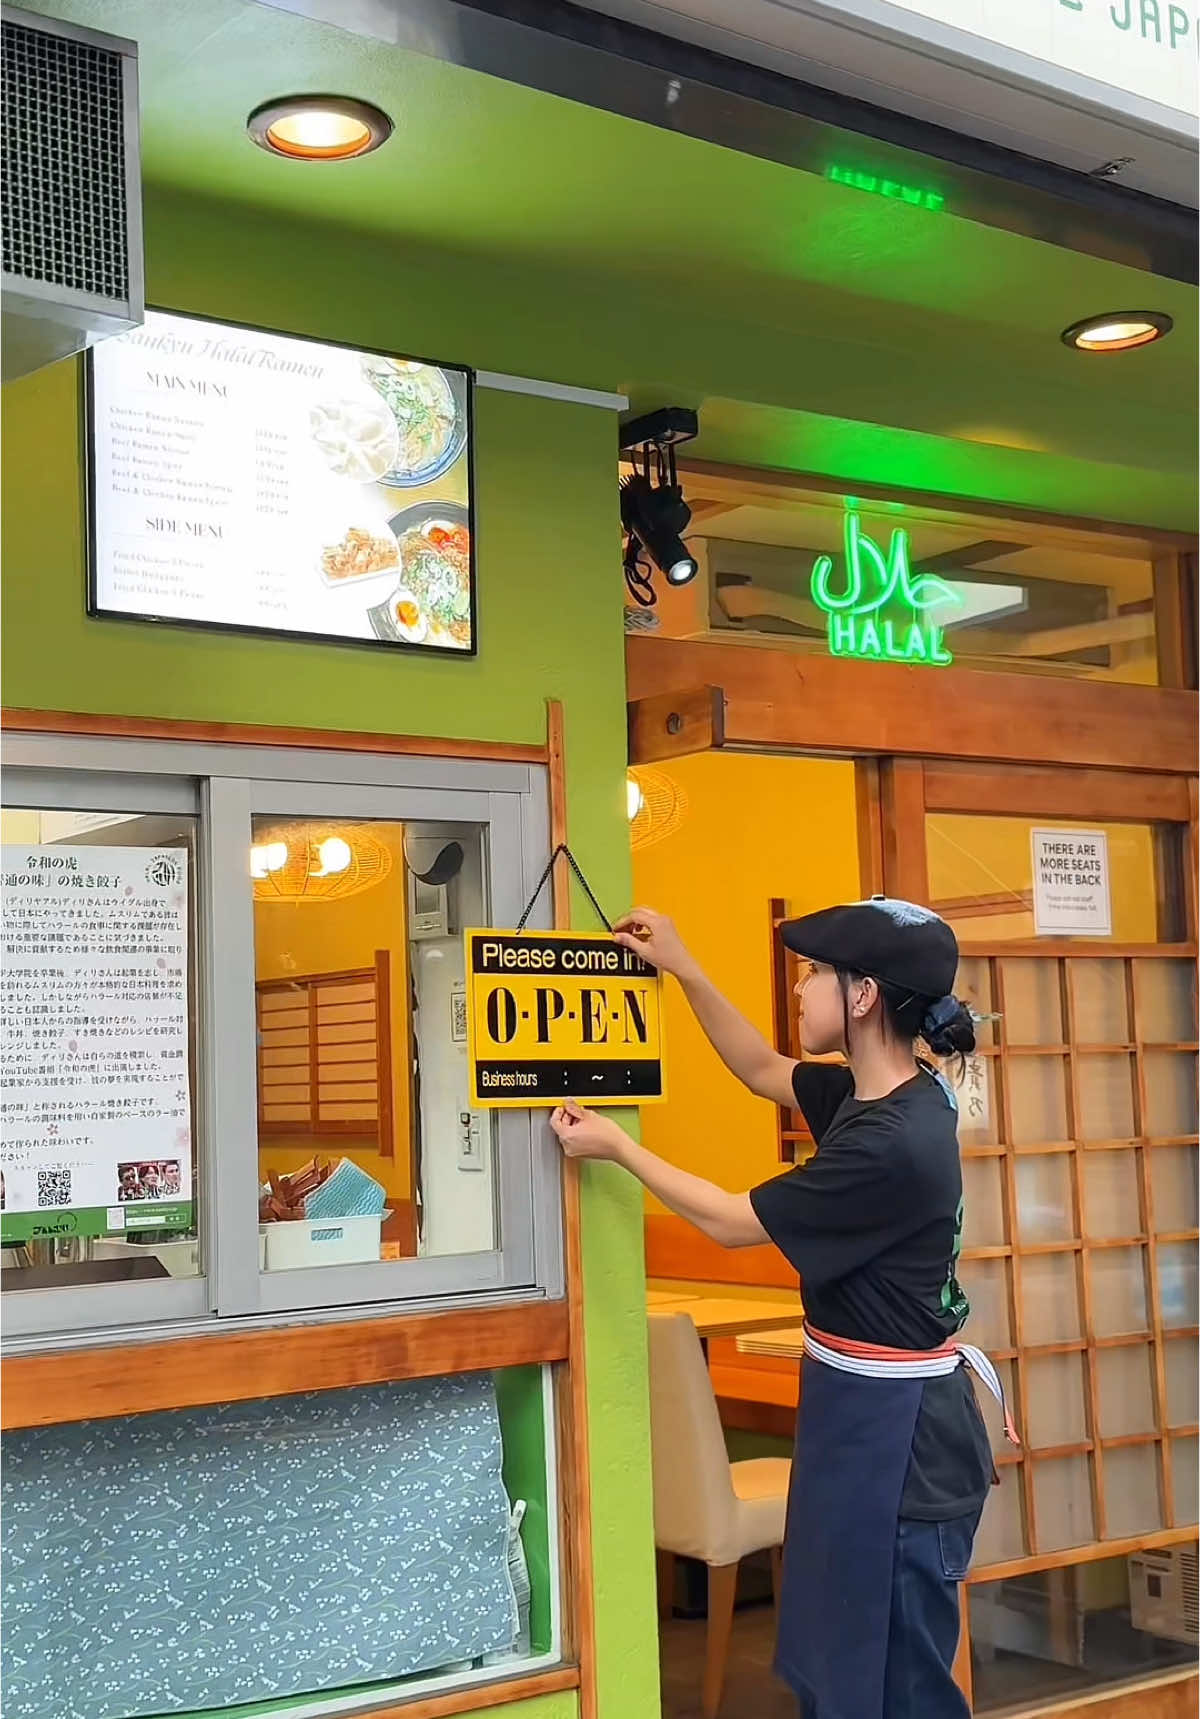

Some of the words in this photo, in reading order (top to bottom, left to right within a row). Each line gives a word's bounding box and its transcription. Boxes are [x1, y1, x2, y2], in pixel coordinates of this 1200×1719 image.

[1110, 0, 1199, 60] JAP
[255, 350, 325, 380] Ramen
[146, 371, 186, 391] MAIN
[188, 378, 231, 399] MENU
[145, 516, 181, 535] SIDE
[184, 520, 223, 540] MENU
[811, 511, 966, 616] حلال
[829, 612, 953, 666] HALAL
[1042, 842, 1074, 855] THERE
[1076, 844, 1096, 856] ARE
[26, 855, 78, 871] 令和の虎
[1040, 858, 1070, 870] MORE
[1071, 859, 1101, 871] SEATS
[1041, 873, 1052, 884] IN
[1054, 873, 1073, 885] THE
[1075, 874, 1102, 886] BACK
[482, 943, 556, 968] Please
[561, 949, 619, 970] come
[481, 1070, 516, 1087] Business
[516, 1070, 538, 1087] hours
